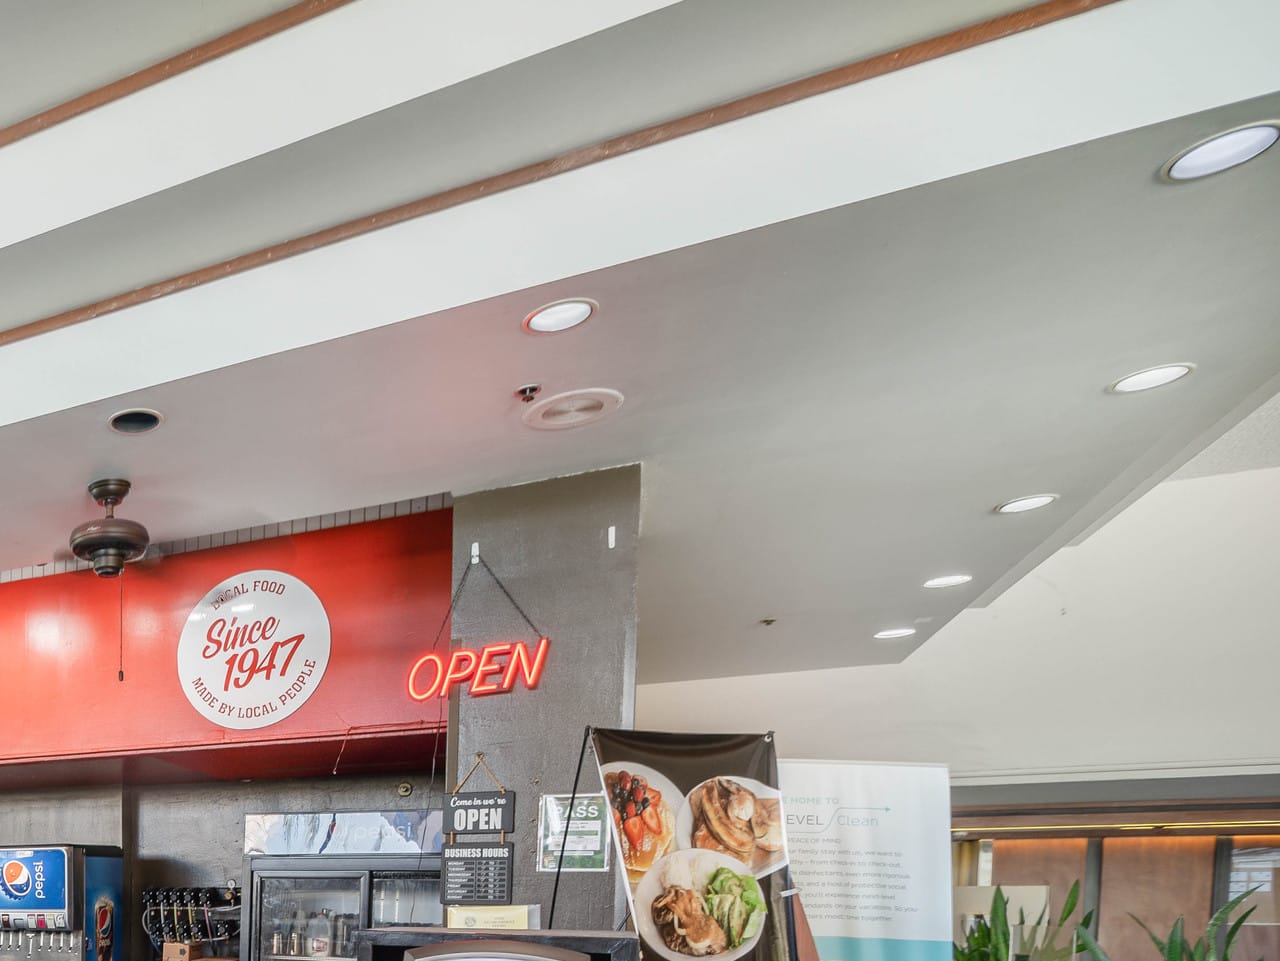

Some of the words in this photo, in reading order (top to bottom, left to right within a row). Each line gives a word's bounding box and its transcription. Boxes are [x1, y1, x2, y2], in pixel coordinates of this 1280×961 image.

[210, 583, 249, 611] LOCAL
[253, 580, 286, 596] FOOD
[202, 616, 280, 660] Since
[223, 633, 305, 692] 1947
[408, 637, 550, 700] OPEN
[191, 676, 219, 709] MADE
[218, 702, 235, 717] BY
[237, 701, 278, 719] LOCAL
[278, 658, 317, 706] PEOPLE
[450, 796, 472, 808] Come
[472, 798, 482, 806] in
[483, 797, 507, 806] we're
[790, 797, 817, 805] HOME
[826, 797, 840, 805] TO
[453, 807, 503, 831] OPEN
[786, 814, 825, 826] EVEL
[836, 815, 880, 827] Clean
[444, 848, 481, 858] BUSINESS
[482, 847, 509, 858] HOURS
[33, 860, 46, 899] pepsi
